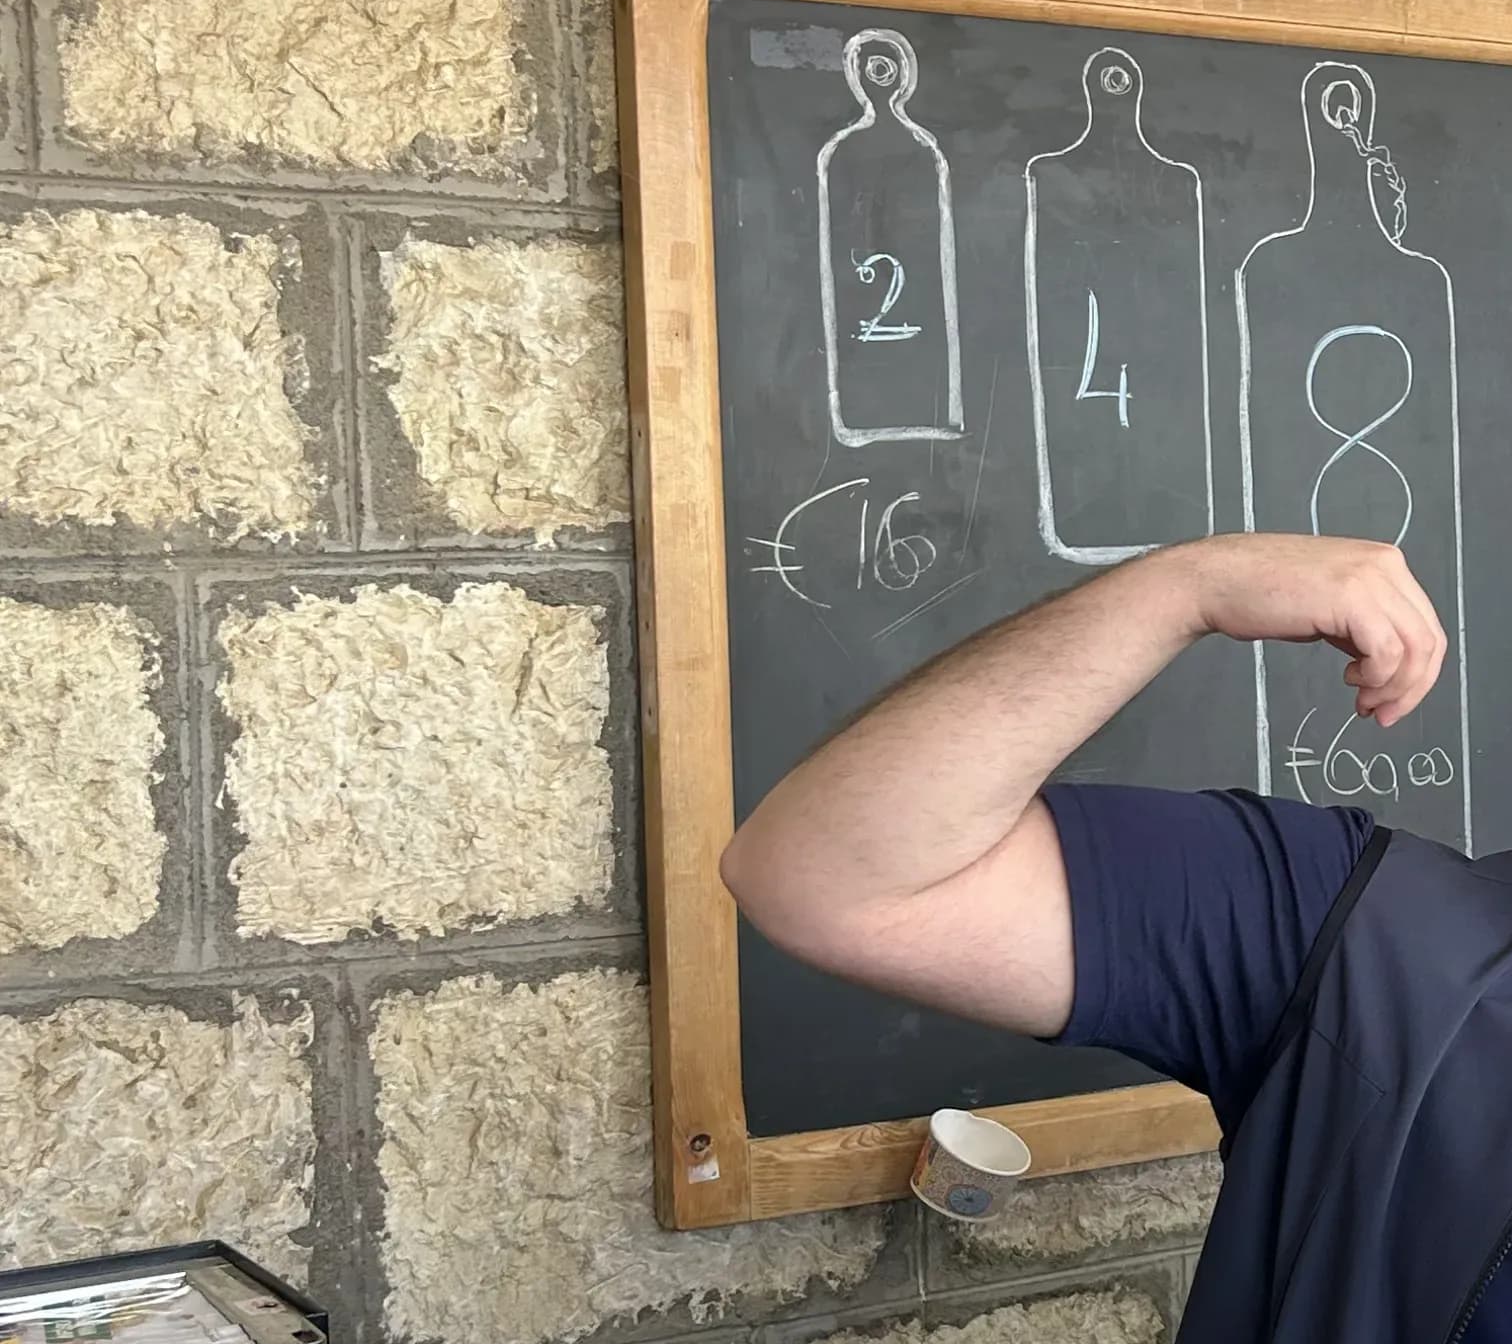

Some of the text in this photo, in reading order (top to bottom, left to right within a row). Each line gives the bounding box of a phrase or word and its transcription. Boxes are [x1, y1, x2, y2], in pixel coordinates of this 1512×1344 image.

[851, 249, 922, 342] 2
[1076, 288, 1133, 428] 4
[1306, 324, 1414, 537] 8
